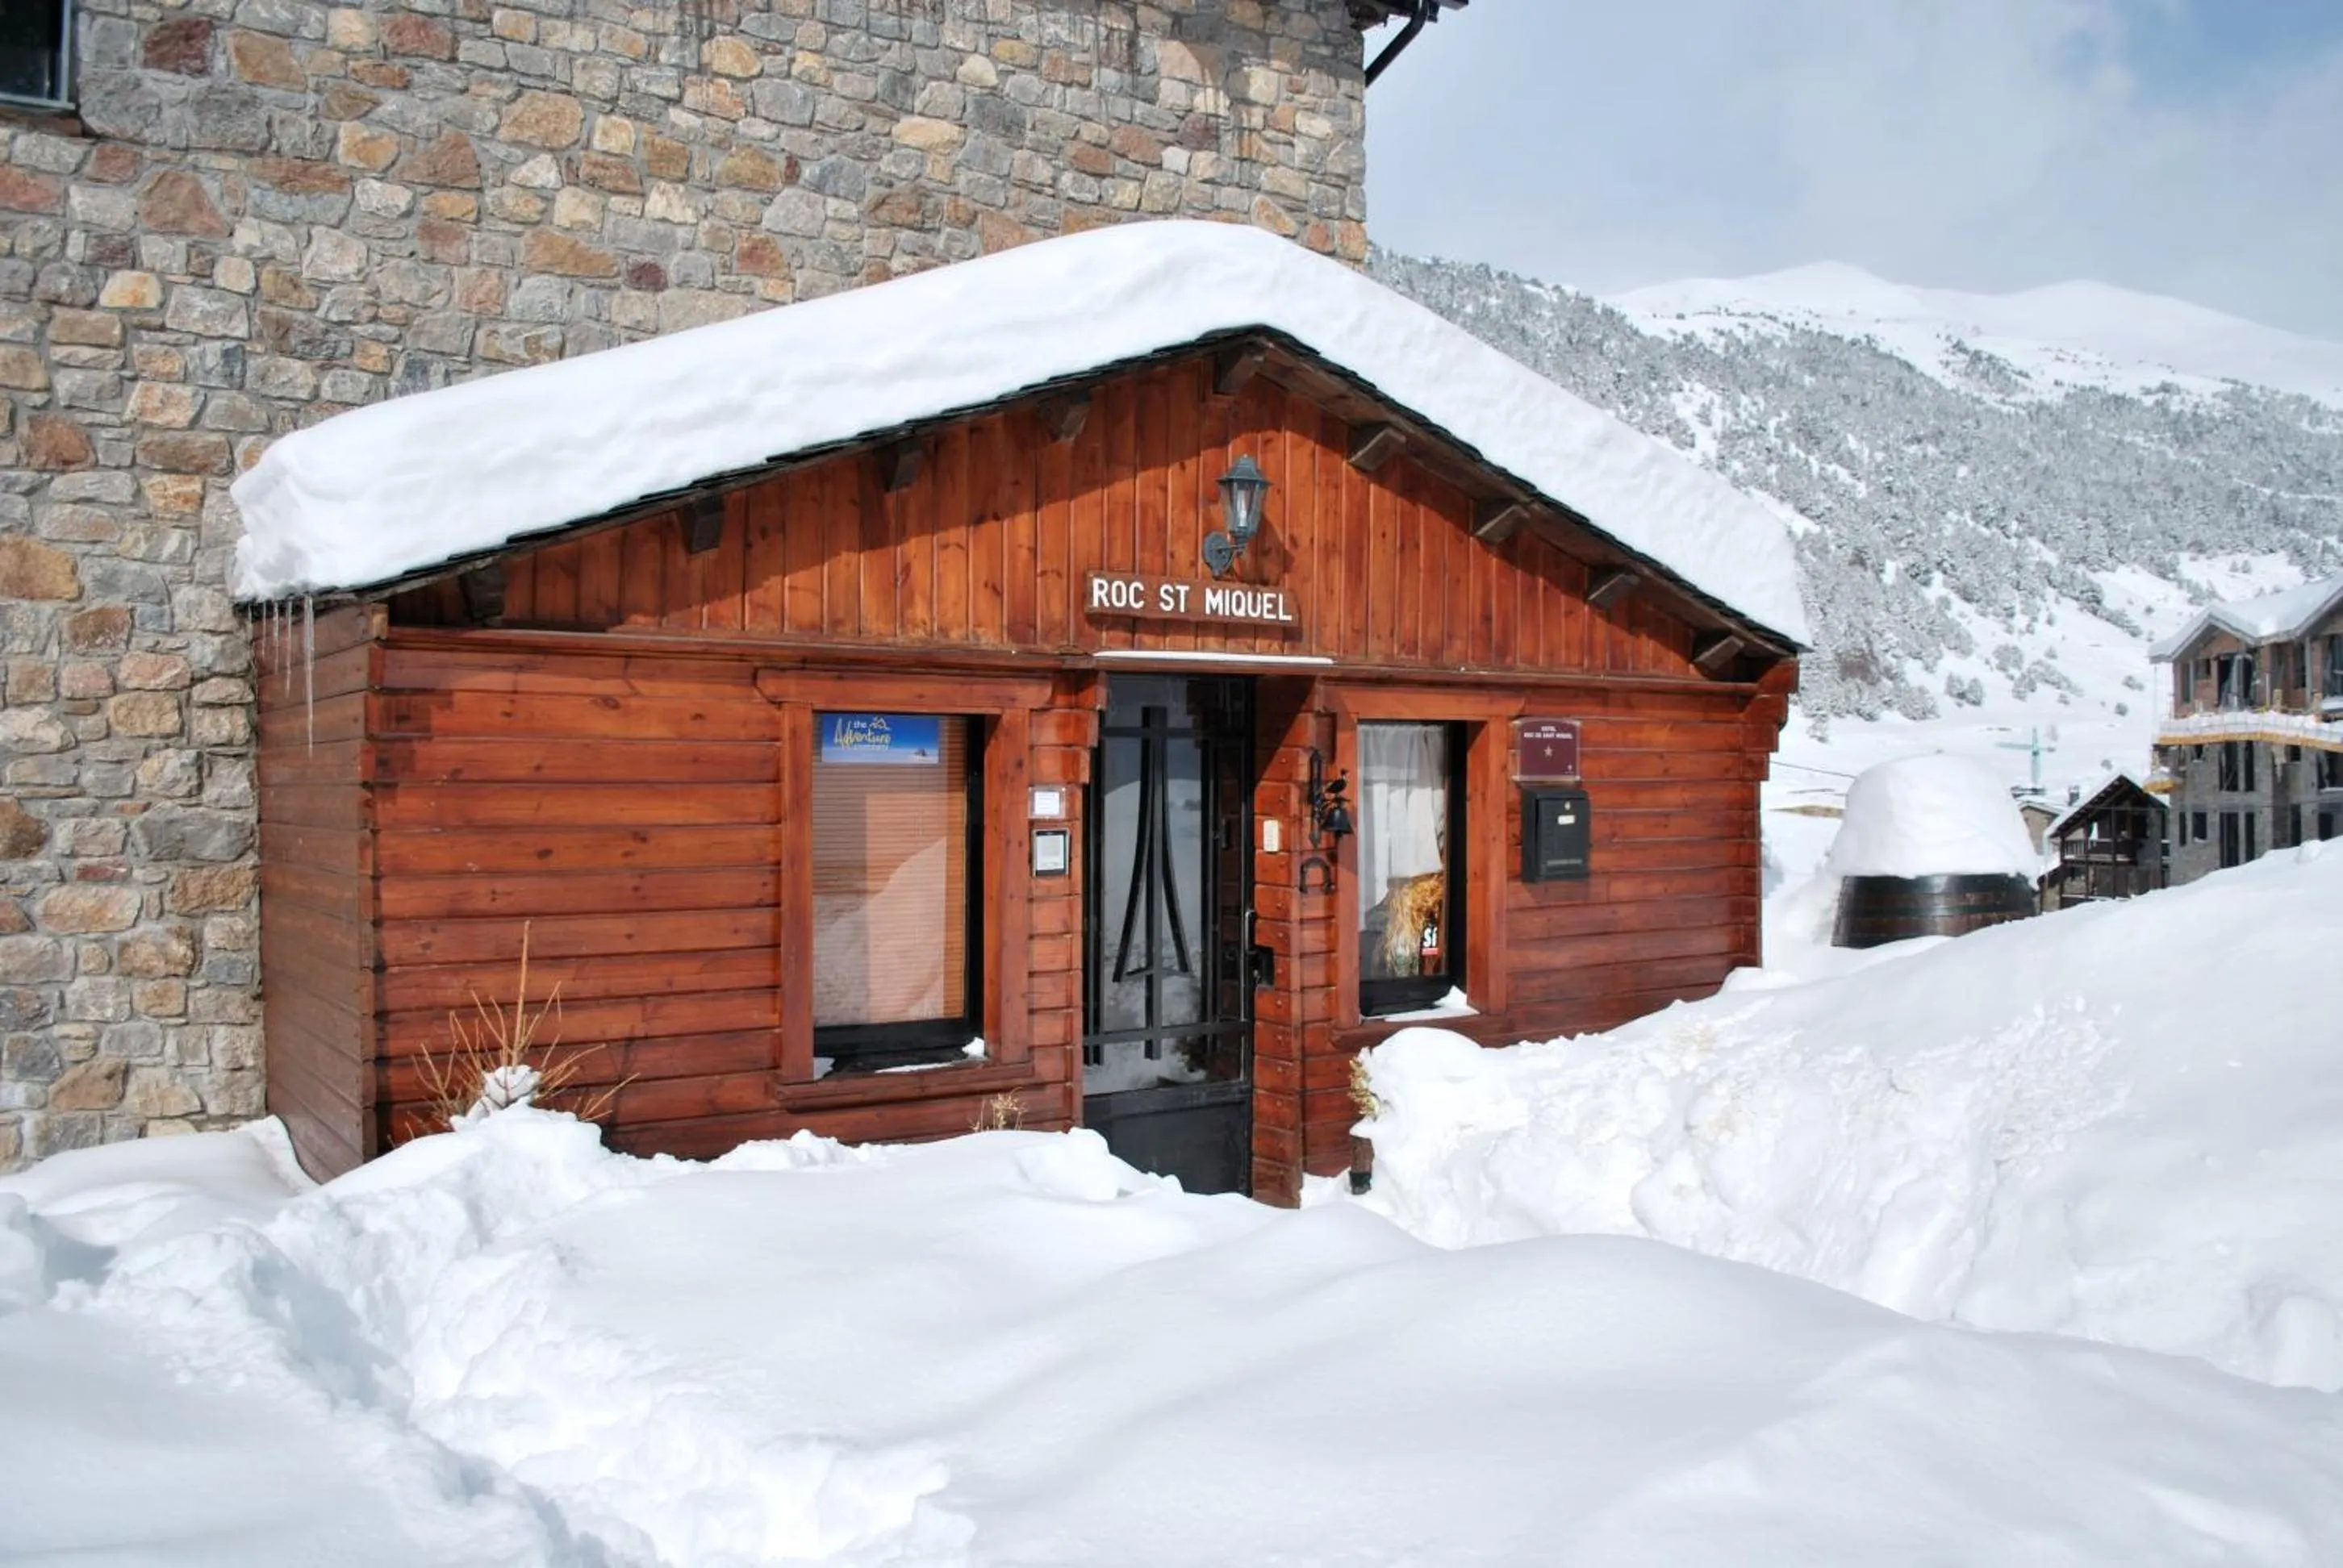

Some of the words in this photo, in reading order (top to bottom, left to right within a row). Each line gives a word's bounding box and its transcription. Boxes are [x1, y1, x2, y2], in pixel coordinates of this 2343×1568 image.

[1092, 578, 1144, 607] ROC
[1159, 584, 1189, 612] ST
[1205, 588, 1292, 620] MIQUEL
